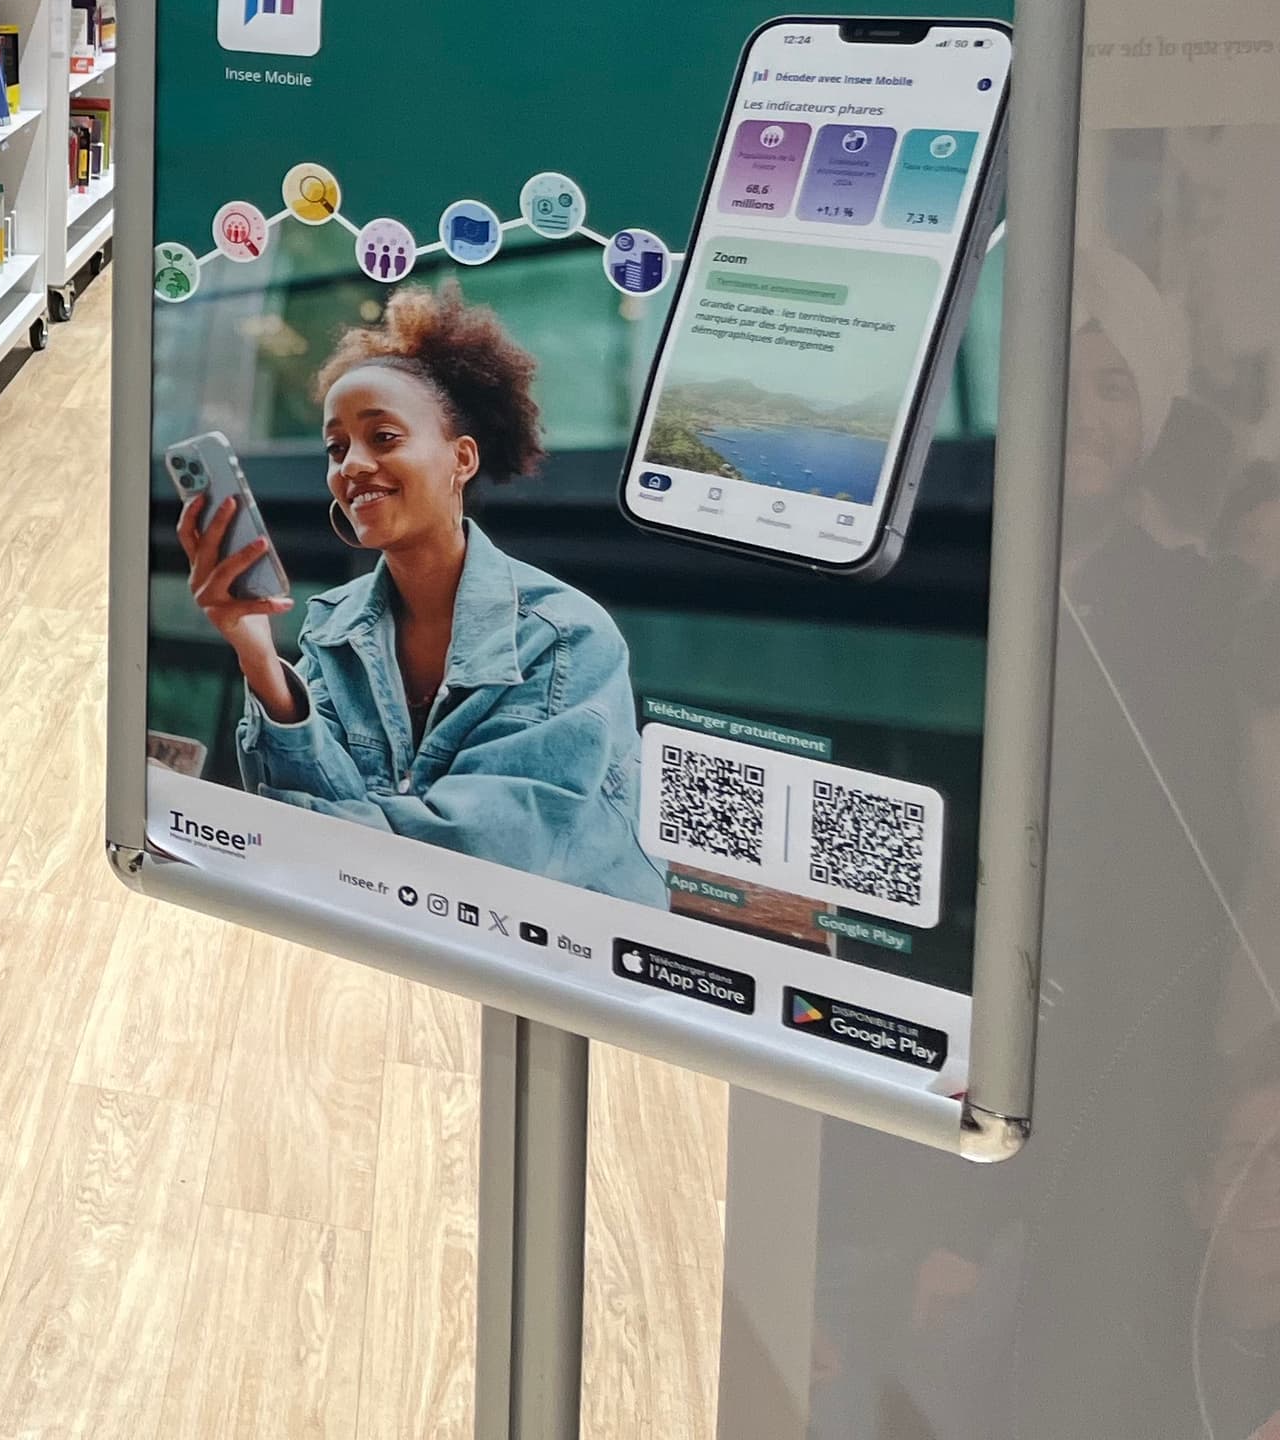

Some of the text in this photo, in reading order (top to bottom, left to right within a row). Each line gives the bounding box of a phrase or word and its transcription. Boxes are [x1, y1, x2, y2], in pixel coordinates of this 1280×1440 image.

[784, 35, 811, 45] 12:24
[225, 67, 312, 87] Insee Mobile
[775, 73, 913, 87] Décoder avec Insee Mobile
[743, 100, 884, 117] Les indicateurs phares
[745, 184, 770, 195] 68,6
[731, 198, 775, 211] millions
[842, 207, 854, 218] %
[906, 212, 939, 225] 7,3 %
[712, 252, 748, 265] Zoom
[695, 312, 841, 340] marqués par des dynamiques
[699, 298, 736, 311] Grande
[783, 307, 796, 318] les
[798, 310, 850, 326] territoires
[852, 315, 896, 333] français
[691, 324, 835, 353] démographiques divergentes
[647, 700, 828, 753] Télécharger gratuitement
[169, 810, 247, 851] Insee
[339, 869, 390, 897] insee.fr
[669, 872, 739, 903] App Store
[817, 915, 905, 948] Google Play
[649, 963, 746, 1005] l'App Store
[708, 970, 733, 985] dans
[831, 1005, 920, 1037] DISPONIBLE SUR
[830, 1018, 938, 1064] Google Play
